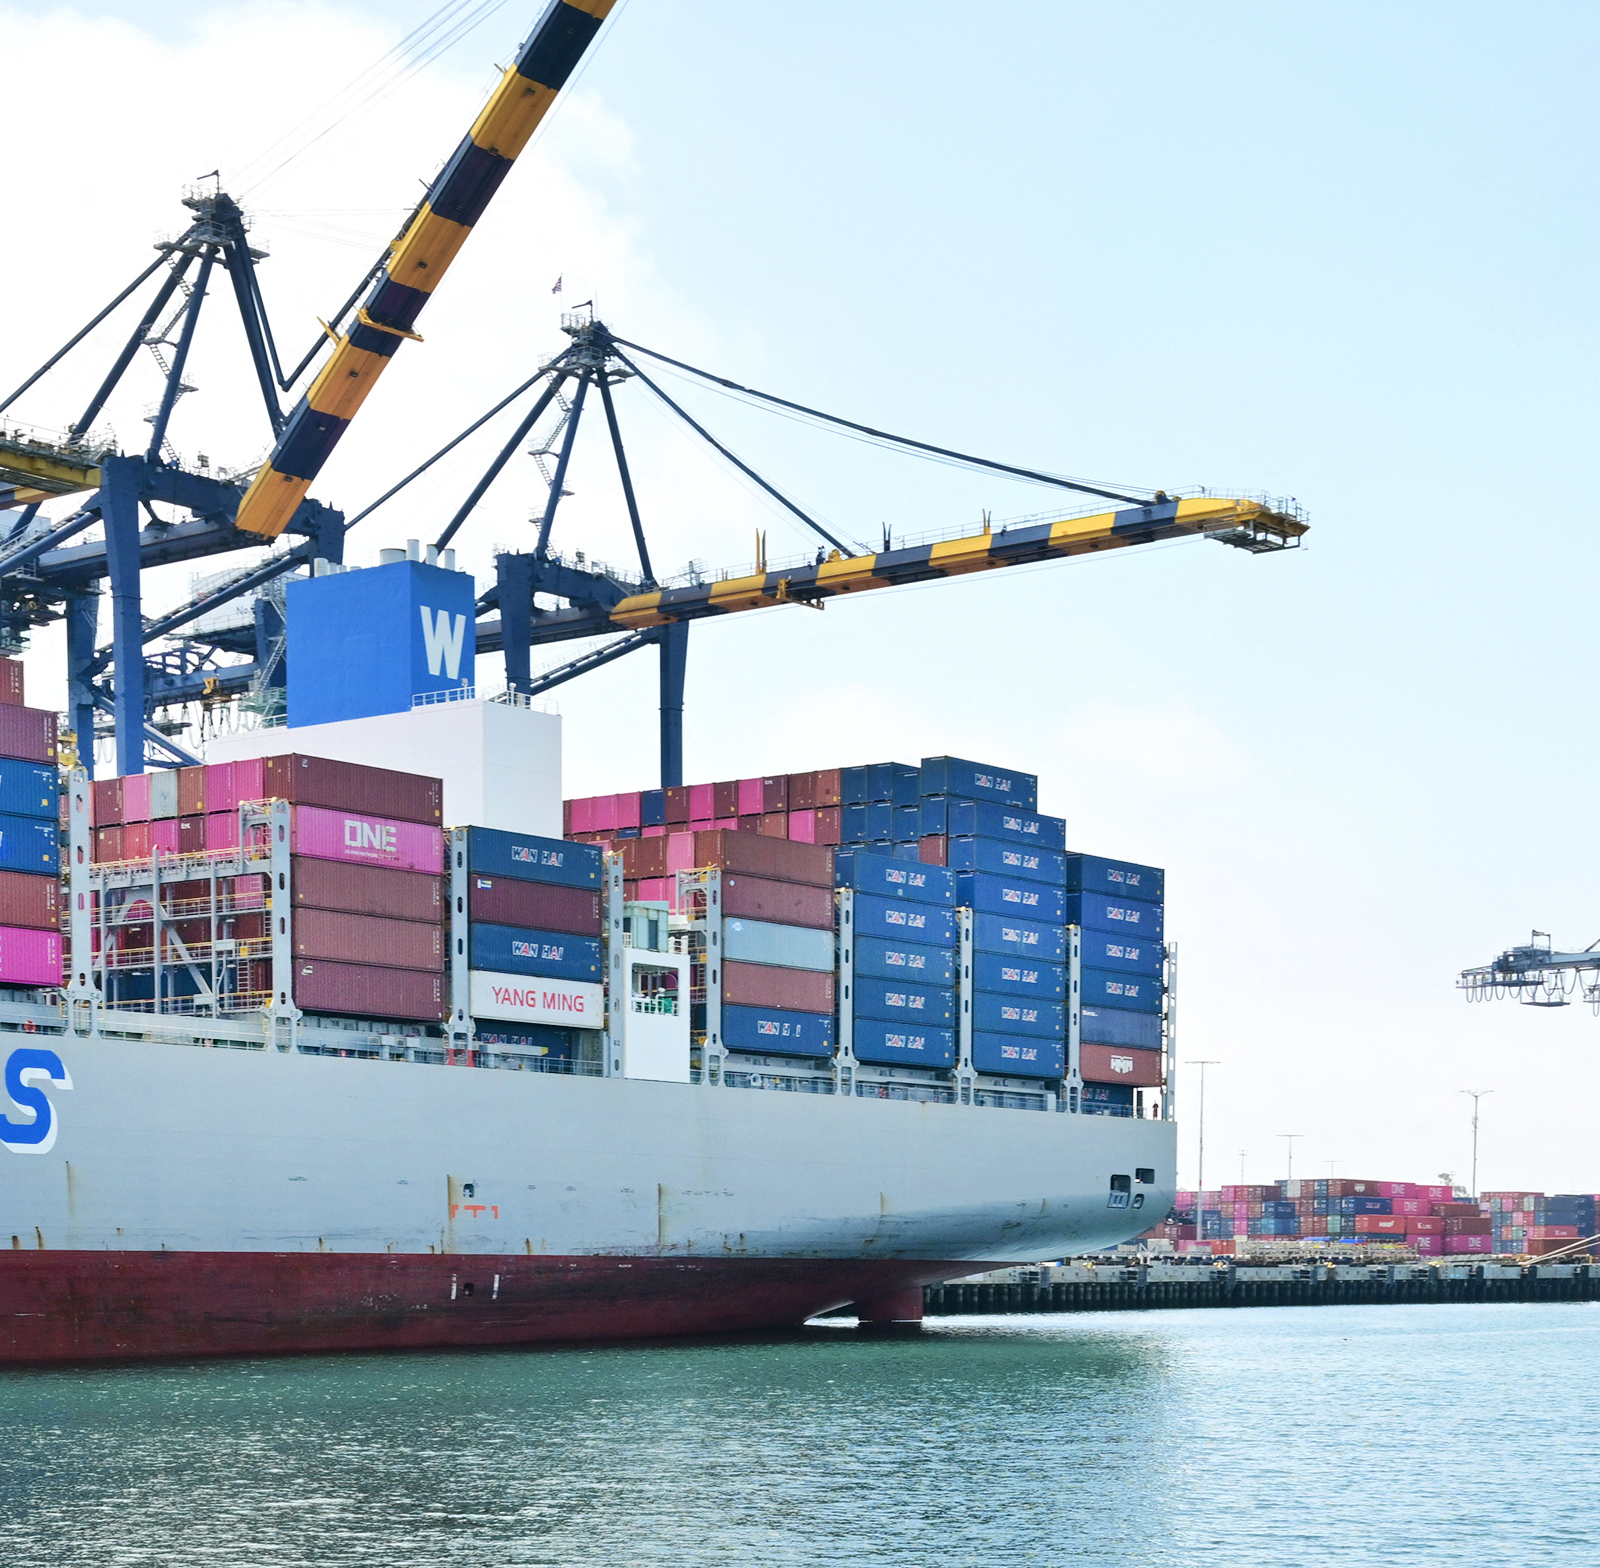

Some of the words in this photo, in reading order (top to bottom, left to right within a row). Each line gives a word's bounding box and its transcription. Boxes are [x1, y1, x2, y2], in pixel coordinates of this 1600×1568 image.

[420, 605, 467, 680] W
[344, 819, 397, 852] ONE
[512, 846, 538, 863] WAN
[541, 850, 563, 867] HAI
[512, 941, 538, 957] WAN
[542, 945, 564, 960] HAI
[492, 986, 536, 1008] YANG
[542, 992, 584, 1012] MING
[757, 1020, 780, 1036] WAN
[1391, 1184, 1405, 1195] ONE
[1429, 1187, 1442, 1198] ONE
[1404, 1201, 1418, 1212] ONE
[1468, 1237, 1482, 1247] ONE
